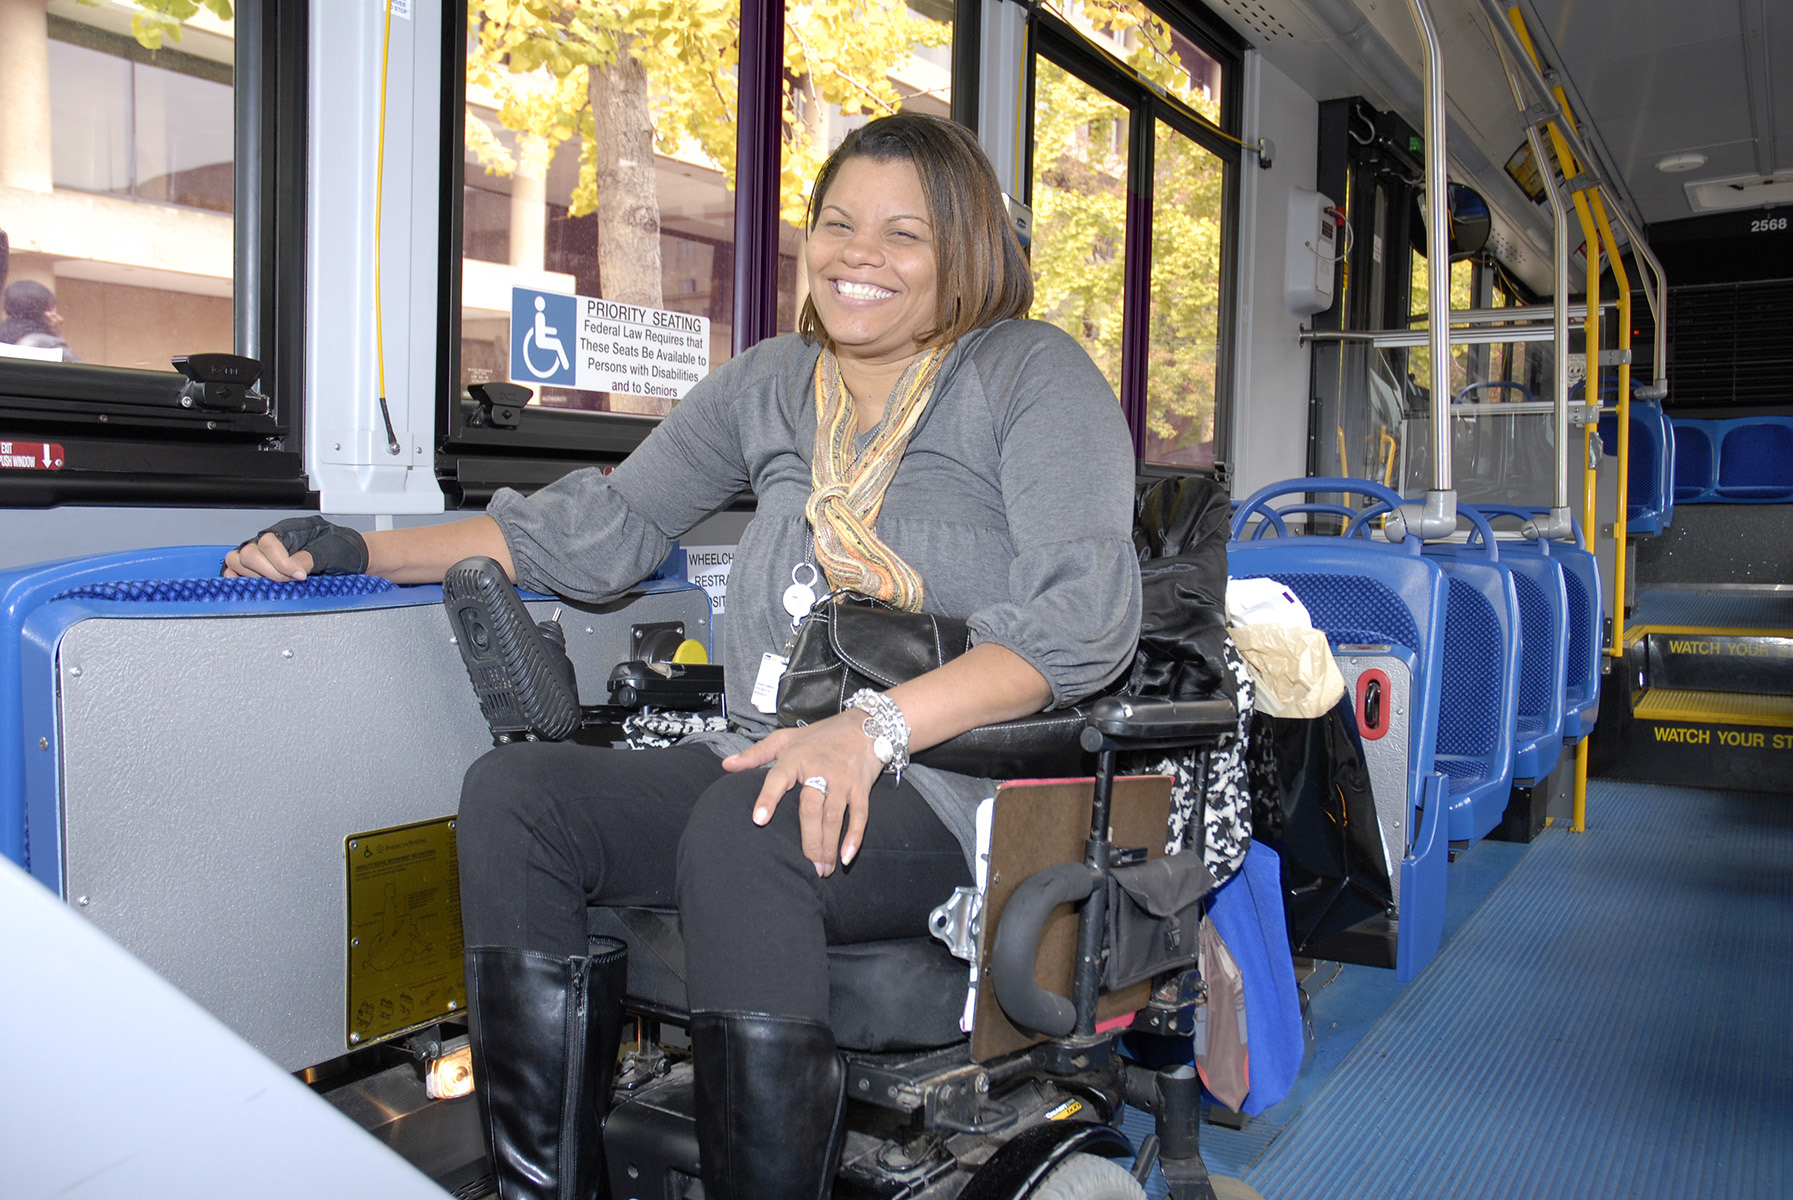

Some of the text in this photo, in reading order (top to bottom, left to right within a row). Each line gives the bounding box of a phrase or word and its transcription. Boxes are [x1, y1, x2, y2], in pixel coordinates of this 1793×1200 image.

[1751, 218, 1787, 233] 2568
[587, 300, 702, 332] PRIORITY SEATING
[584, 319, 703, 349] Federal Law Requires that
[580, 337, 707, 366] These Seats Be Available to
[588, 357, 699, 382] Persons with Disabilities
[612, 380, 678, 397] and to Seniors
[1, 442, 13, 454] EXIT
[13, 455, 36, 468] WINDOW
[1670, 640, 1721, 655] WATCH
[1727, 643, 1770, 656] YOUR
[1654, 726, 1711, 744] WATCH
[1717, 730, 1765, 747] YOUR
